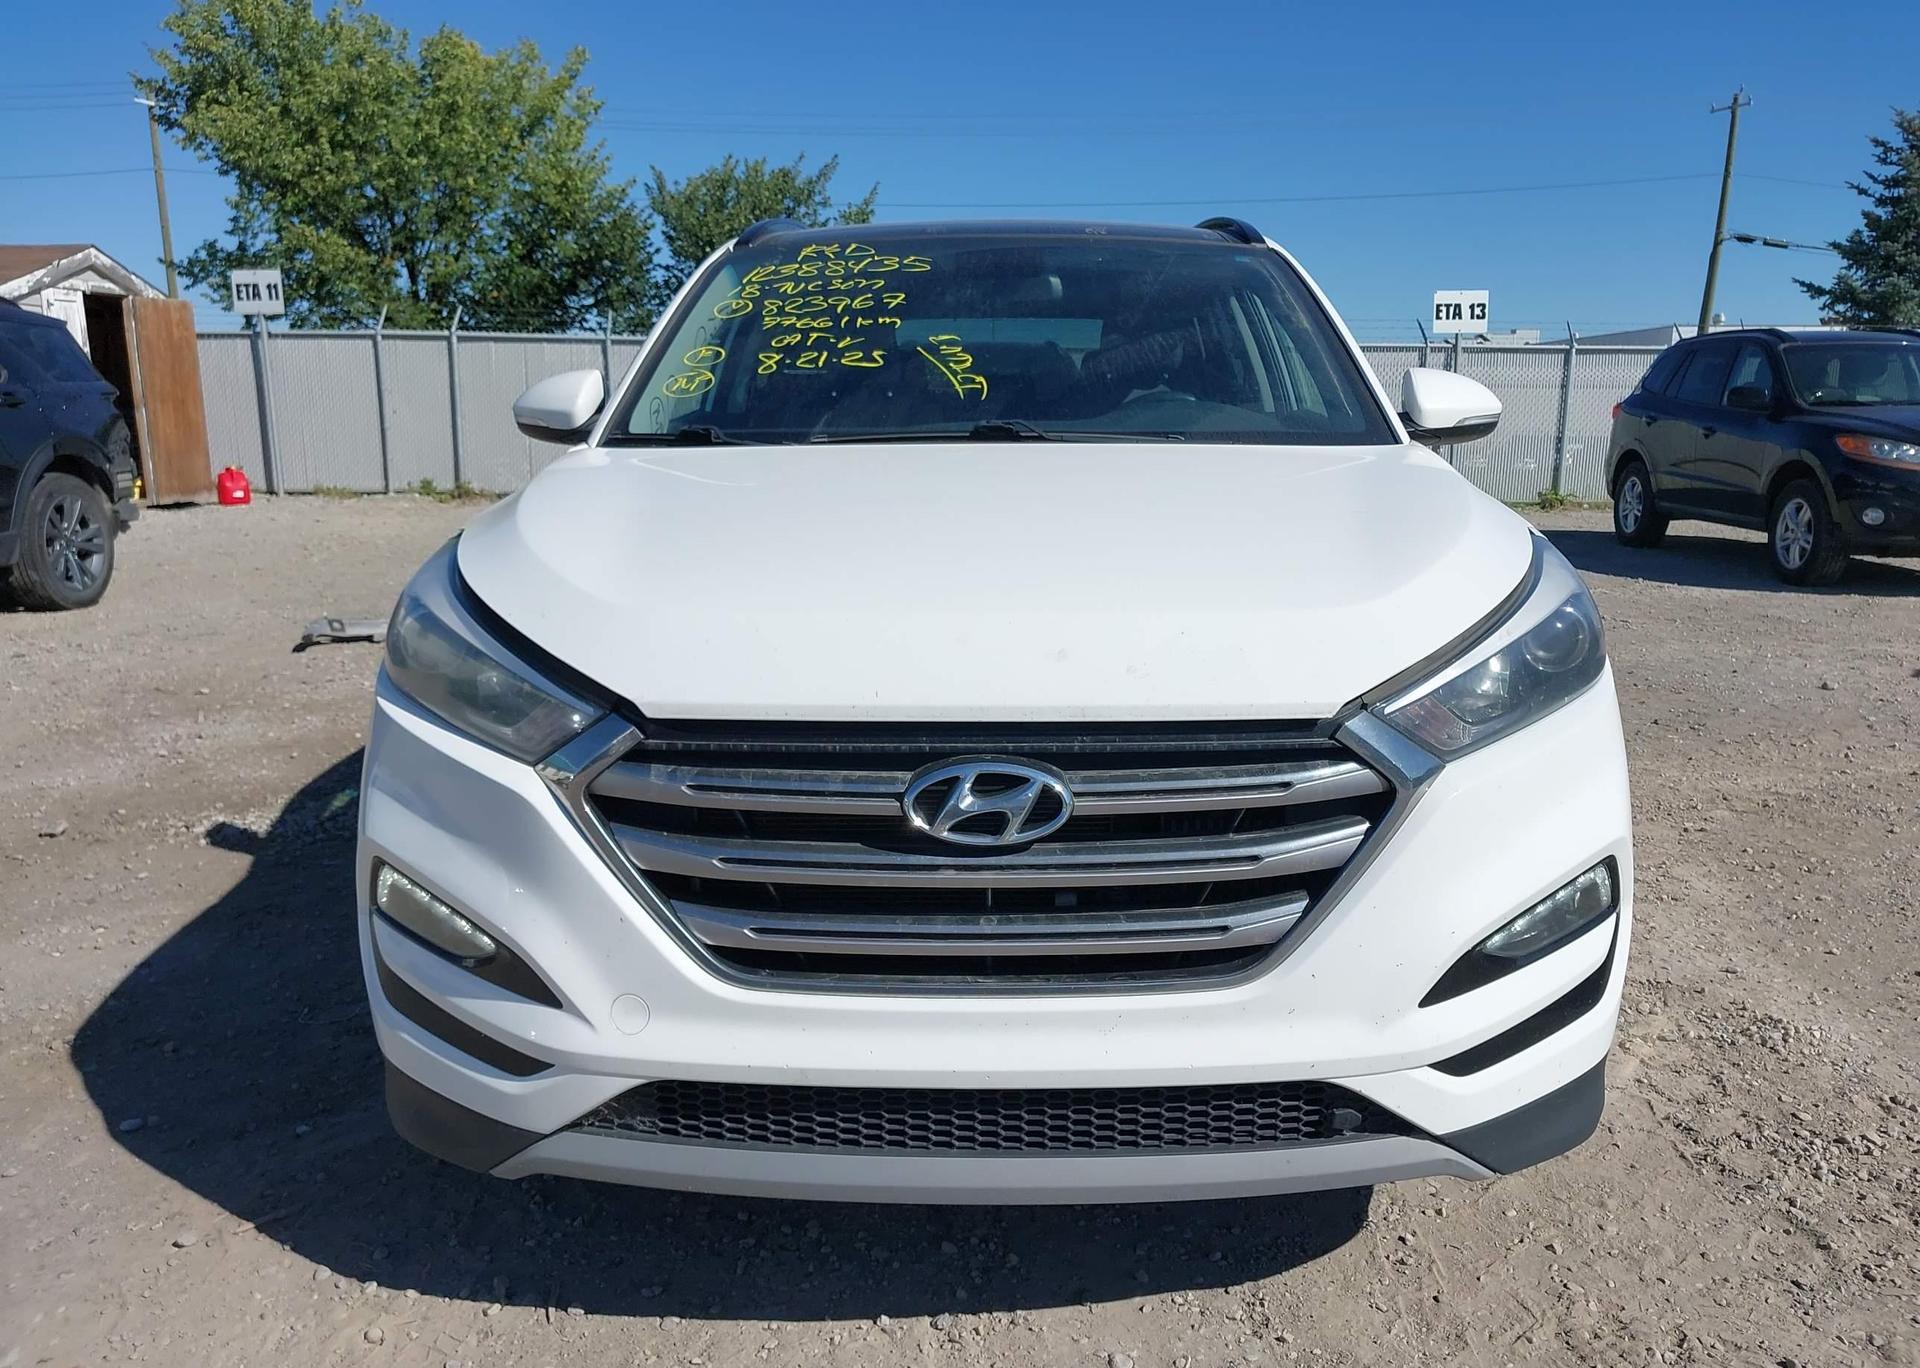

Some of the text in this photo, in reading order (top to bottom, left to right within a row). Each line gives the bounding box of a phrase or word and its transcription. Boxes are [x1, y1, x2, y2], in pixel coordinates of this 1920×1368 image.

[742, 255, 933, 284] 12388435
[235, 283, 280, 301] ETA 11
[762, 293, 907, 316] 823967
[1435, 303, 1487, 320] ETA 13
